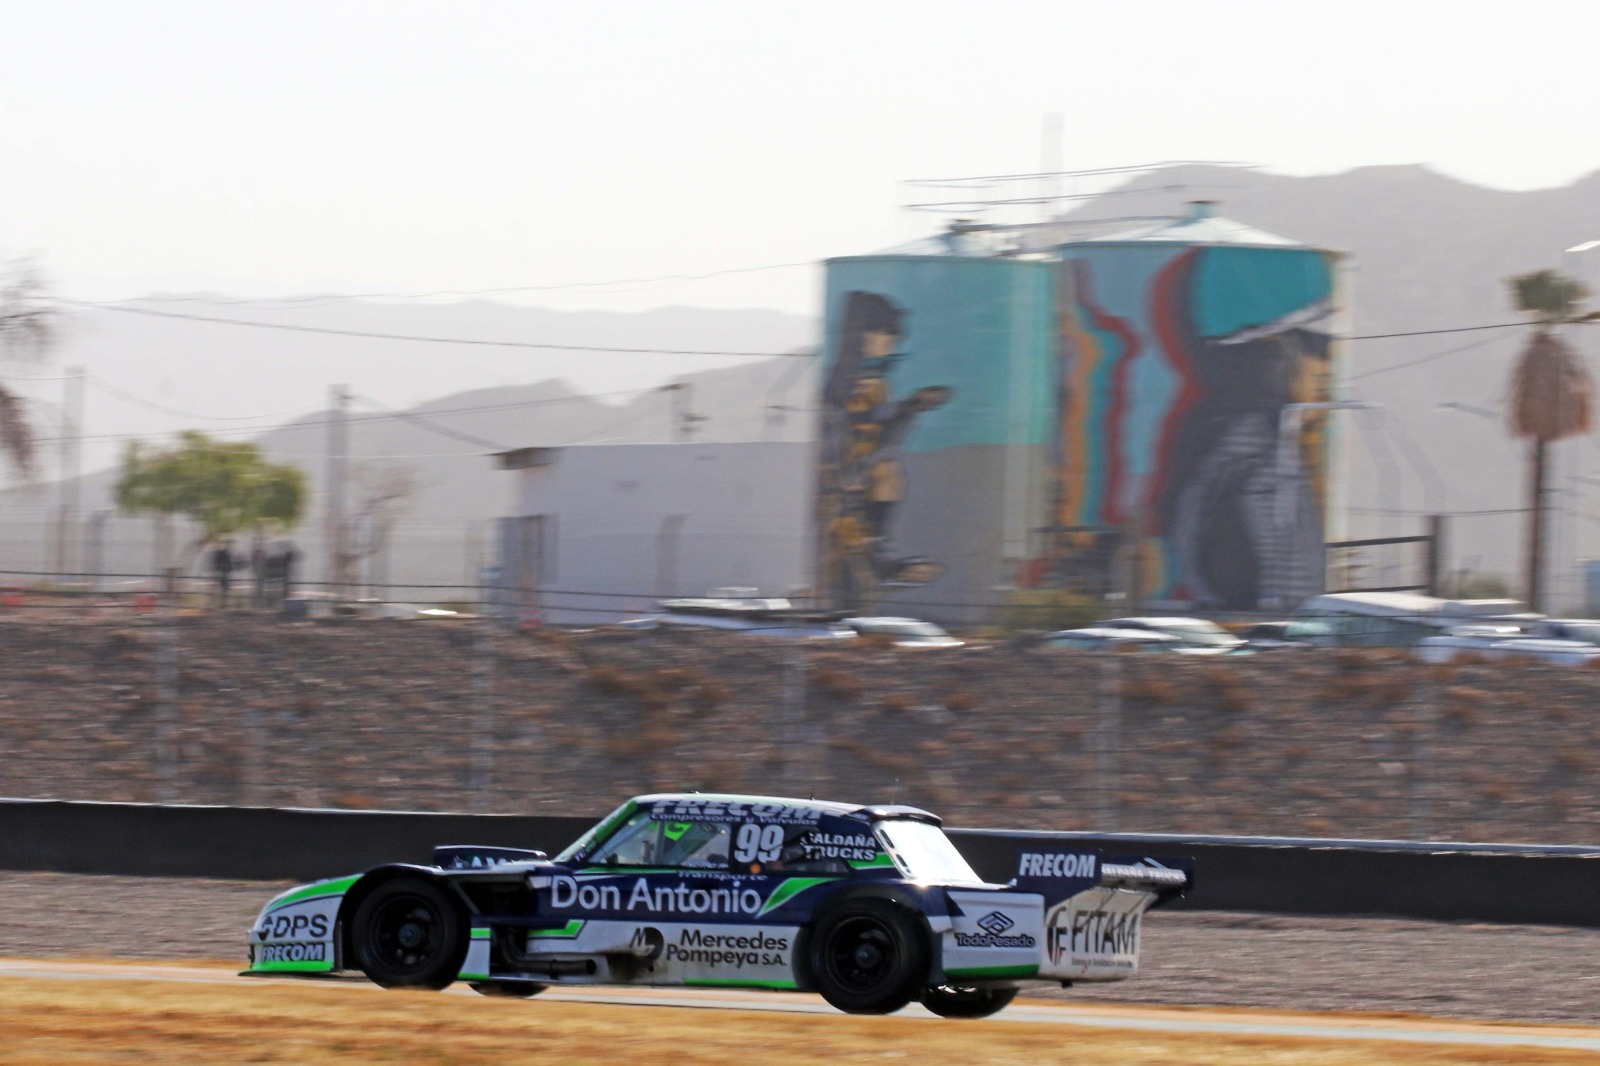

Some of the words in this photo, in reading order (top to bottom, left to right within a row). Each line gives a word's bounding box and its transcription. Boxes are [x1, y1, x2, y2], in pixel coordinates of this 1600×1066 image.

[651, 813, 741, 824] Compresores
[652, 800, 821, 819] FRECOM
[734, 824, 784, 864] 99
[804, 845, 876, 861] TRUCKS
[1019, 853, 1096, 878] FRECOM
[551, 875, 620, 910] Don
[627, 878, 762, 914] Antonio
[273, 914, 328, 938] DPS
[680, 929, 787, 950] Mercedes
[955, 933, 1035, 947] TodoPesado
[262, 943, 324, 961] FRECOM
[665, 944, 759, 968] Pompeya
[762, 953, 787, 966] S.A.
